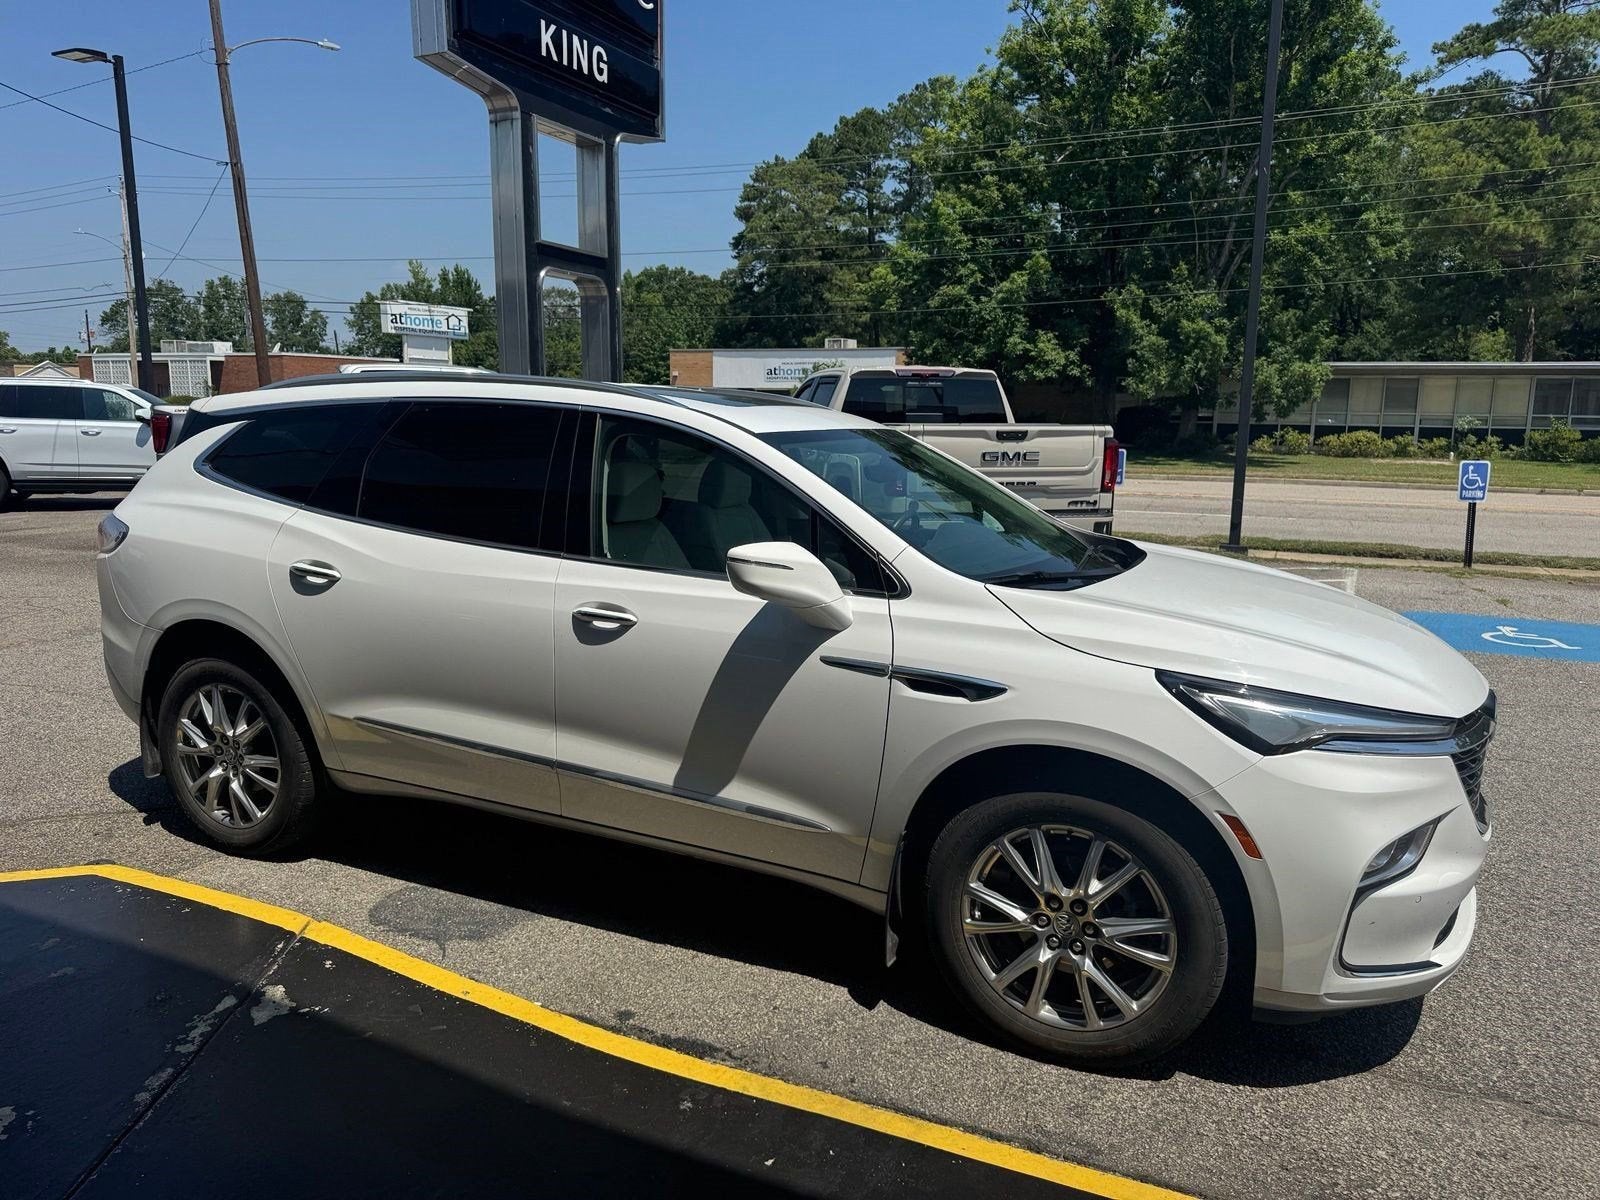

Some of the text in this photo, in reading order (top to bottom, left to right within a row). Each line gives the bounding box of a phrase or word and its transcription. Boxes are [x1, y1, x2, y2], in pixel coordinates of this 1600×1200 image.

[540, 18, 608, 84] KING
[390, 311, 443, 329] athome
[391, 325, 449, 336] HOSPITAL EQUIPMENT
[982, 451, 1040, 462] GMC
[1462, 490, 1484, 498] PARKING
